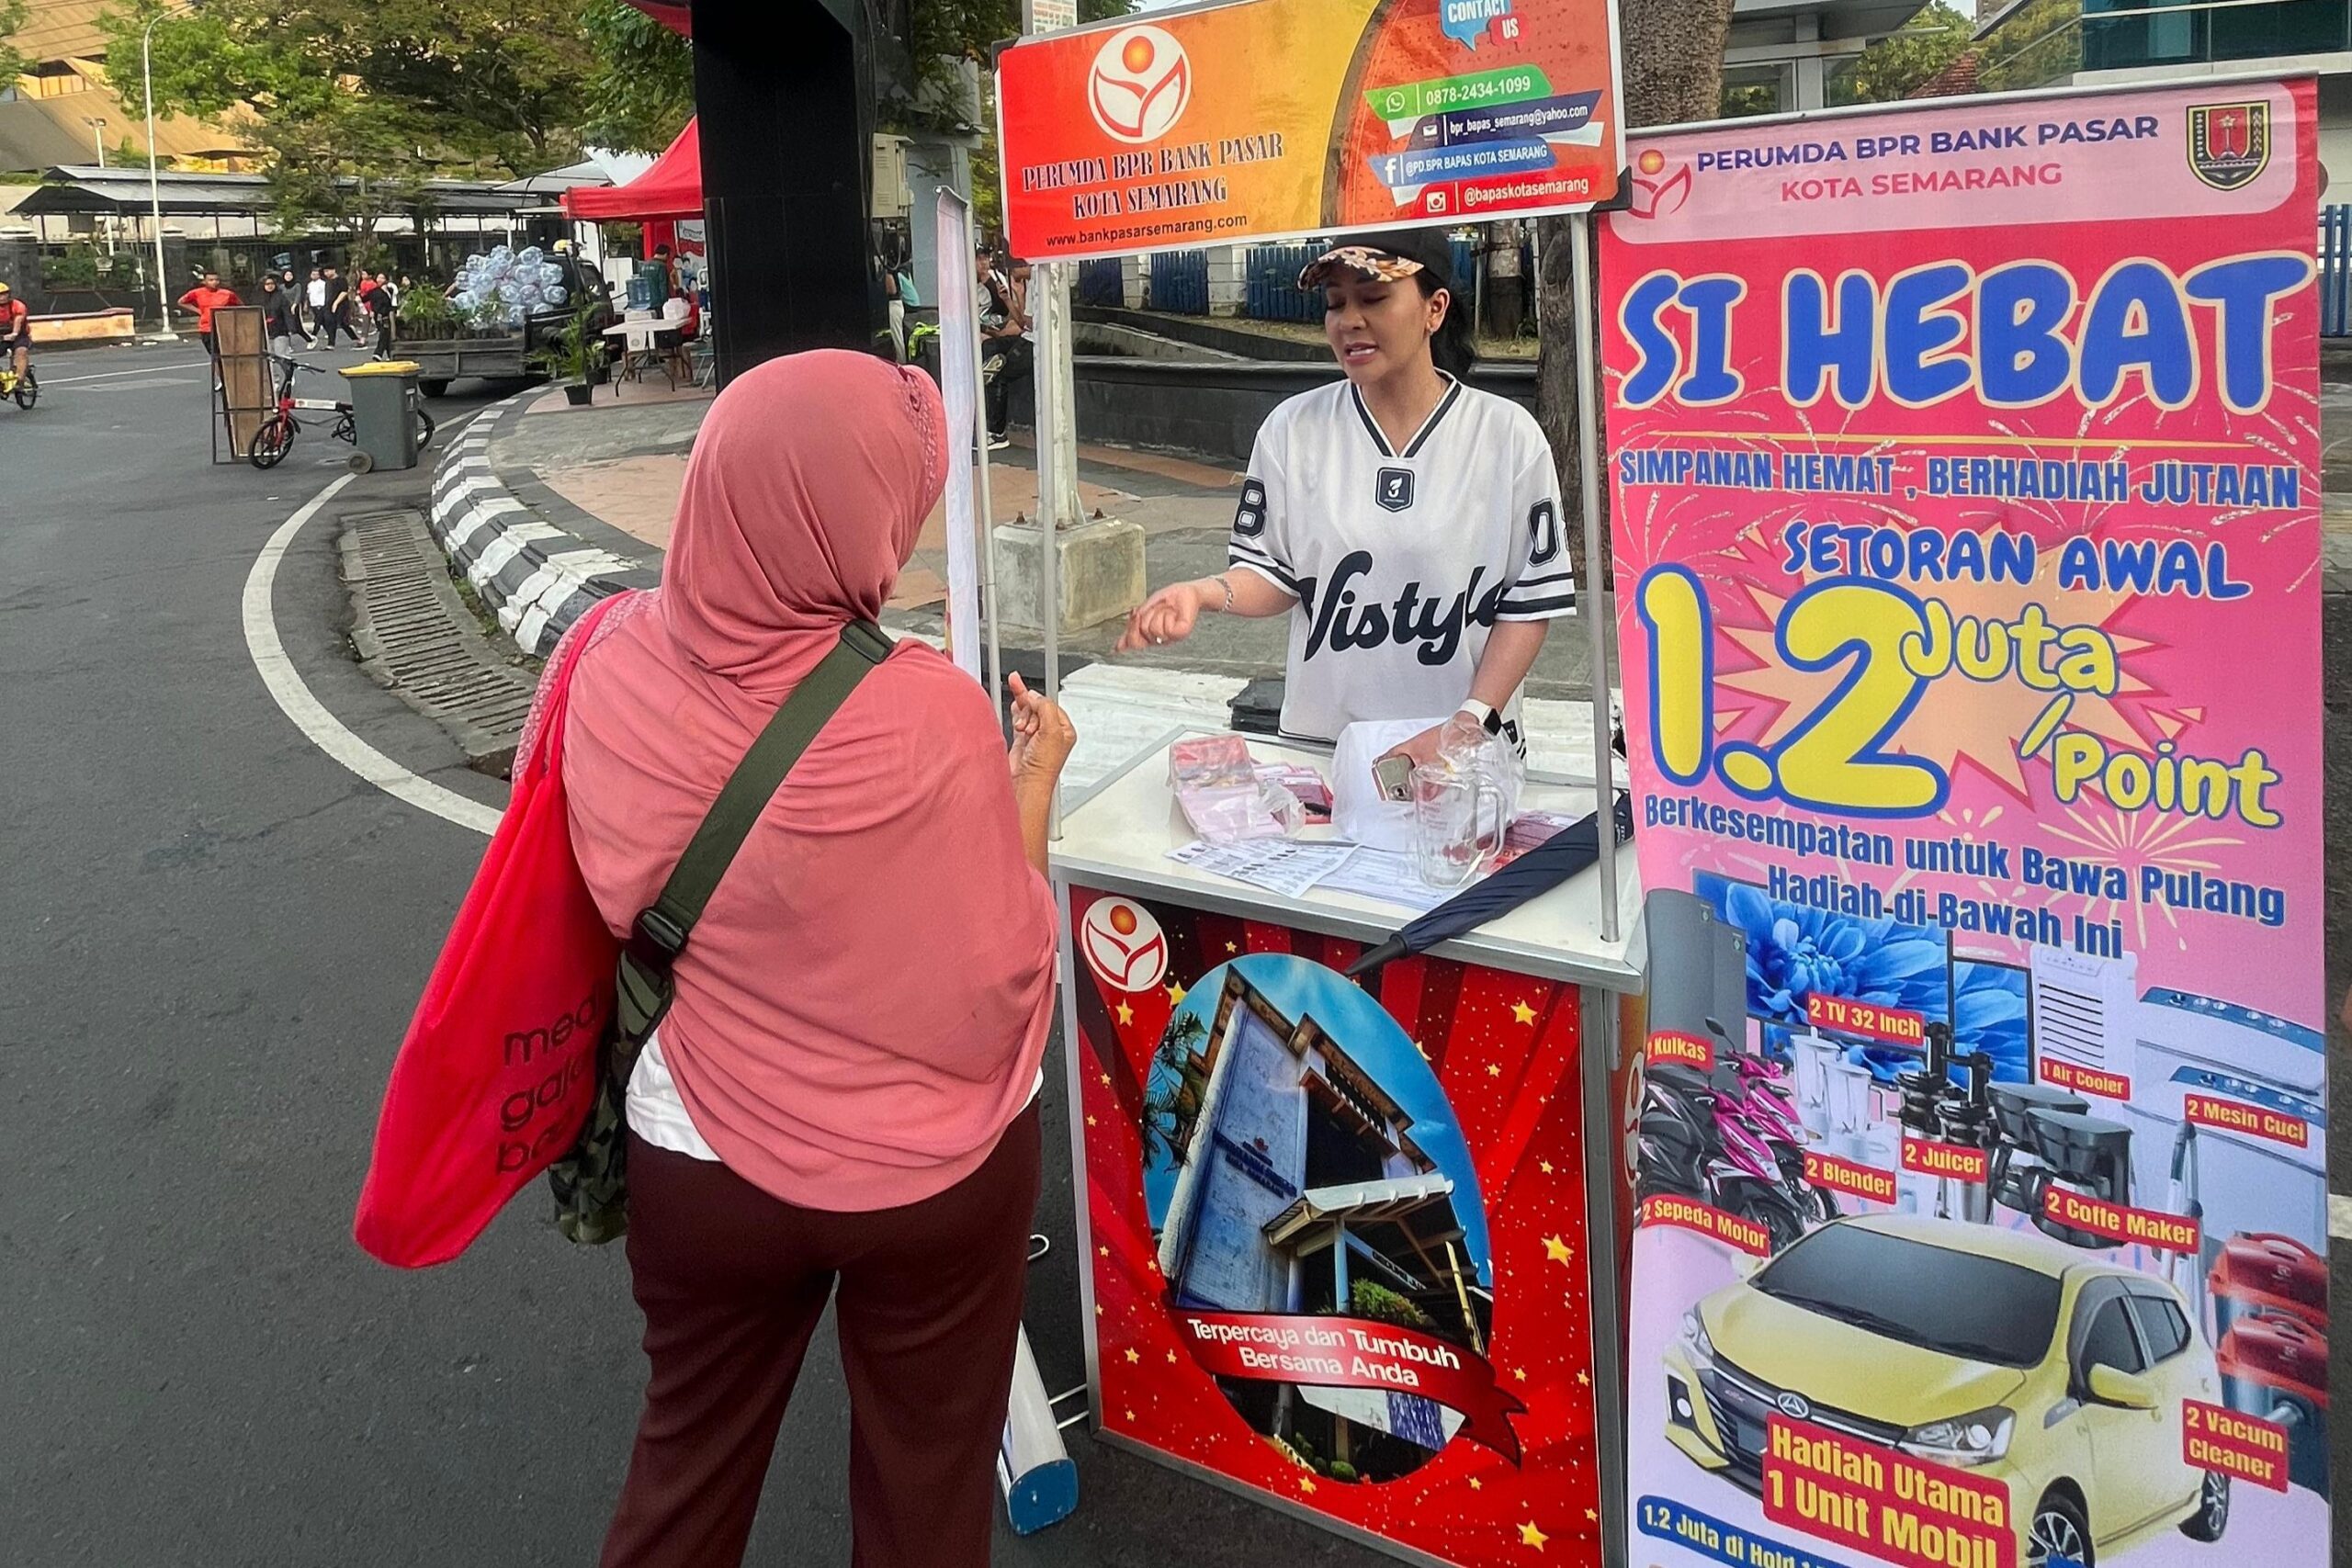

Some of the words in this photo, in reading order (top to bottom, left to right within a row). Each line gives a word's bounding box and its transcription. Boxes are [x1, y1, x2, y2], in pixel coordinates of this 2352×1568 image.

[1447, 0, 1507, 23] CONTACT
[1501, 18, 1519, 39] US
[1426, 75, 1531, 106] 0878-2434-1099
[1450, 105, 1588, 136] bpr_bapas_semarang@yahoo.com
[1023, 157, 1107, 192] PERUMDA
[1113, 151, 1152, 180] BPR
[1159, 141, 1212, 174] BANK
[1219, 132, 1284, 164] PASAR
[1444, 153, 1472, 170] BAPAS
[1474, 150, 1497, 165] KOTA
[1498, 144, 1547, 163] SEMARANG
[1696, 141, 1845, 173] PERUMDA
[1856, 135, 1919, 162] BPR
[1931, 124, 2025, 154] BANK
[2037, 116, 2158, 147] PASAR
[1073, 189, 1122, 220] KOTA
[1127, 176, 1227, 213] SEMARANG
[1464, 177, 1589, 206] @bapaskotasemarang
[1780, 175, 1860, 202] KOTA
[1871, 162, 2063, 197] SEMARANG
[1046, 214, 1248, 247] www.bankpasarsemarang.com
[1618, 268, 1747, 412] SI
[1782, 249, 2318, 415] HEBAT
[1619, 449, 1773, 492] SIMPANAN
[1782, 454, 1894, 497] HEMAT
[1928, 456, 2129, 502] BERHADIAH
[2140, 461, 2300, 509] JUTAAN
[1233, 476, 1267, 540] 8
[1782, 521, 2036, 586] SETORAN
[2057, 536, 2254, 599] AWAL
[1635, 560, 1951, 820] 1.2
[1900, 596, 2120, 699] Juta
[1645, 793, 1893, 867] Berkesempatan
[1905, 837, 2009, 880] untuk
[2021, 846, 2127, 901] Bawa
[2140, 866, 2286, 927] Pulang
[1767, 863, 1884, 914] Hadiah
[1938, 900, 2063, 950] Bawah
[2074, 919, 2122, 959] Ini
[1810, 998, 1822, 1018] 2
[1826, 1001, 1847, 1024] TV
[1851, 1007, 1874, 1030] 32
[1880, 1012, 1921, 1039] Inch
[1655, 1036, 1706, 1062] Kulkas
[2042, 1061, 2049, 1076] 1
[2052, 1064, 2071, 1084] Air
[2076, 1071, 2124, 1094] Cooler
[2188, 1100, 2199, 1117] 2
[2204, 1101, 2258, 1129] Mesin
[2264, 1116, 2304, 1142] Cuci
[1806, 1157, 1818, 1178] 2
[1823, 1162, 1894, 1197] Blender
[1905, 1143, 1917, 1164] 2
[1922, 1144, 1984, 1175] Juicer
[1644, 1201, 1651, 1222] 2
[1655, 1199, 1713, 1229] Sepeda
[1717, 1214, 1768, 1248] Motor
[2048, 1192, 2060, 1213] 2
[2126, 1214, 2196, 1246] Maker
[1187, 1318, 1300, 1349] Terpercaya
[1305, 1326, 1345, 1348] dan
[1346, 1328, 1461, 1371] Tumbuh
[1238, 1346, 1343, 1375] Bersama
[1351, 1356, 1419, 1387] Anda
[2187, 1406, 2199, 1428] 2
[2207, 1412, 2284, 1453] Vacum
[1771, 1424, 1883, 1493] Hadiah
[1894, 1462, 2004, 1528] Utama
[2189, 1438, 2275, 1481] Cleaner
[1645, 1505, 1671, 1530] 1.2
[1676, 1514, 1720, 1551] Juta
[1725, 1535, 1744, 1561] di
[1769, 1470, 1784, 1508] 1
[1794, 1477, 1871, 1539] Unit
[1883, 1507, 1998, 1568] Mobil
